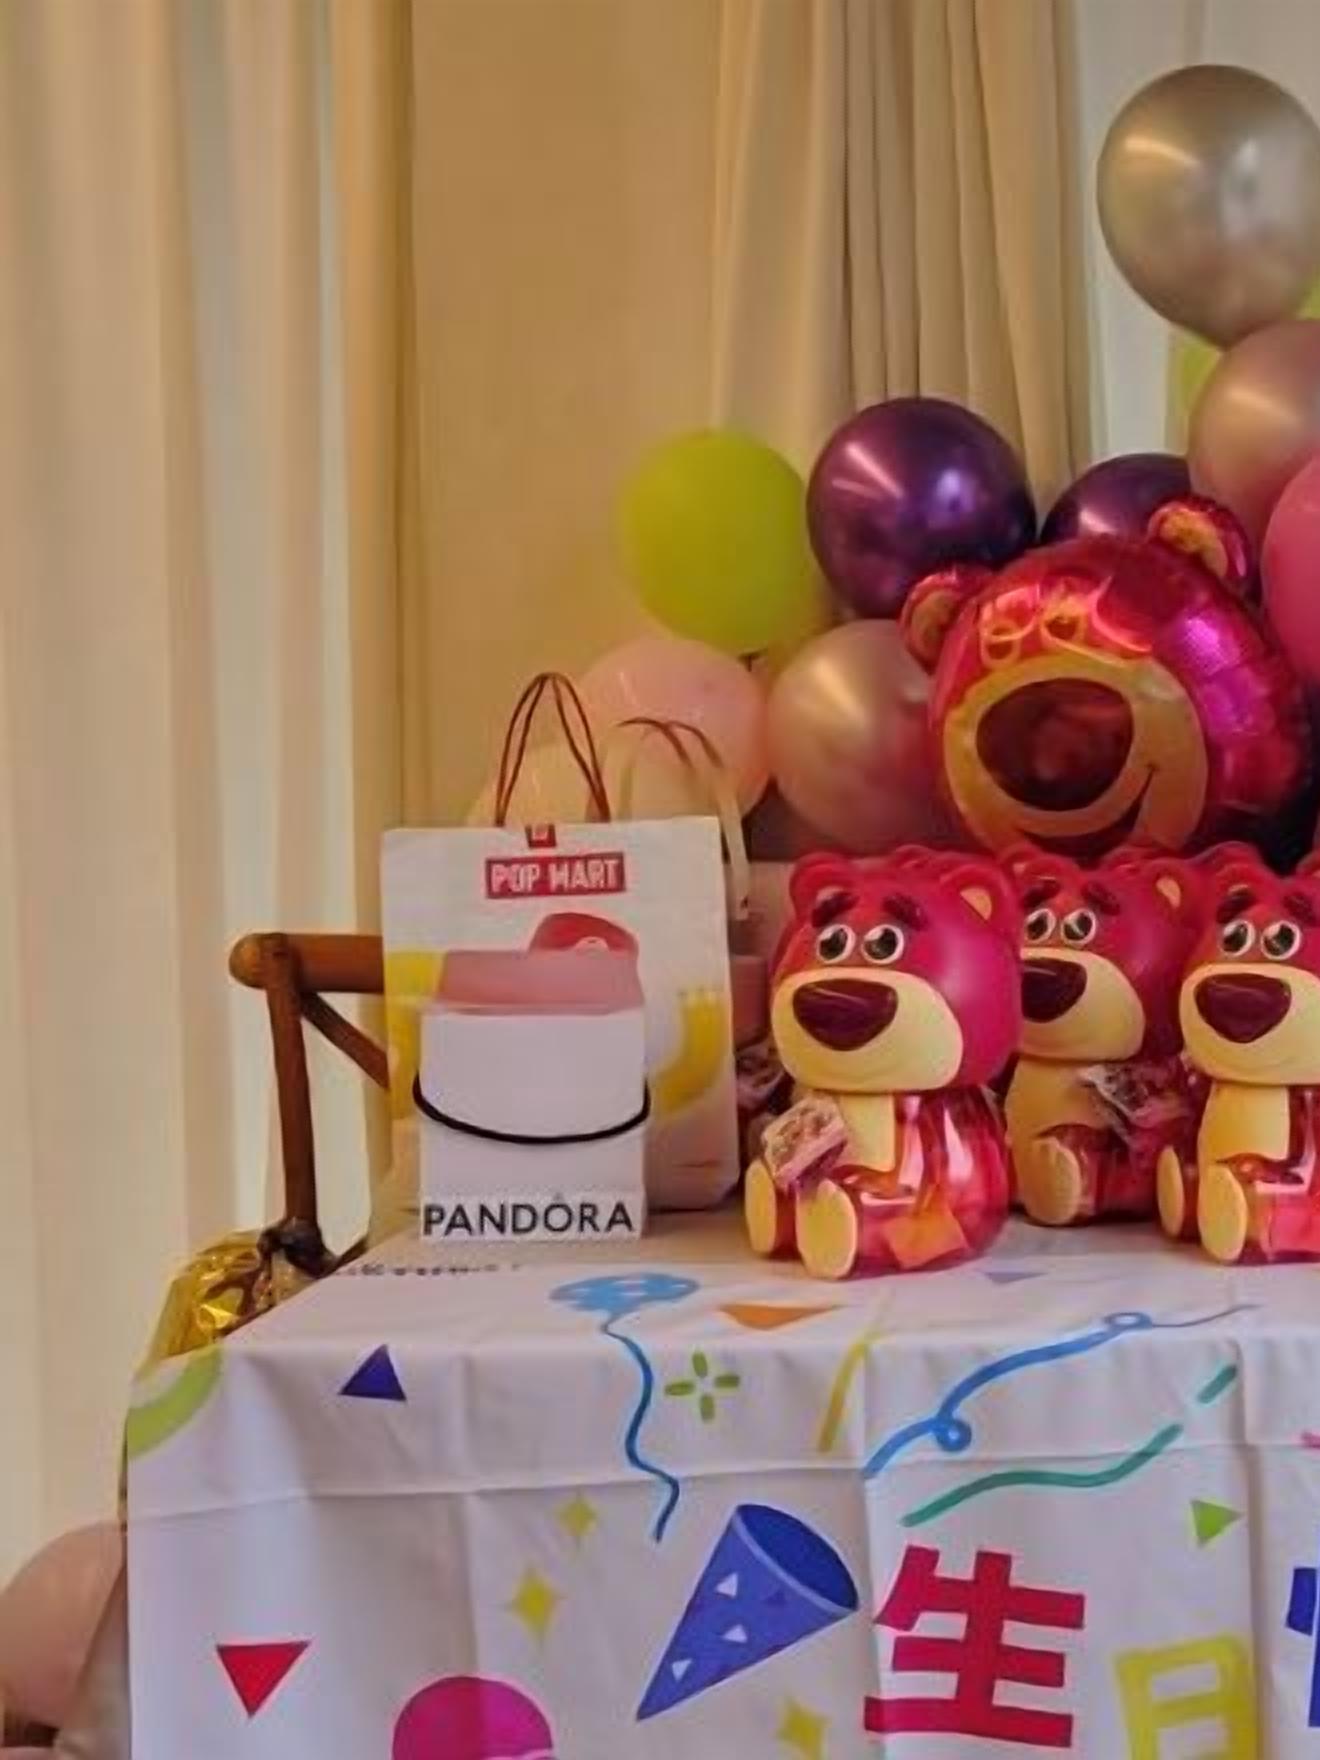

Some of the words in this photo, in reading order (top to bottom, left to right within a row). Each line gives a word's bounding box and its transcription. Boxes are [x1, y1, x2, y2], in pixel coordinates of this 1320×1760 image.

[491, 863, 540, 893] POP
[548, 858, 619, 892] MART
[422, 1200, 634, 1237] PANDORA
